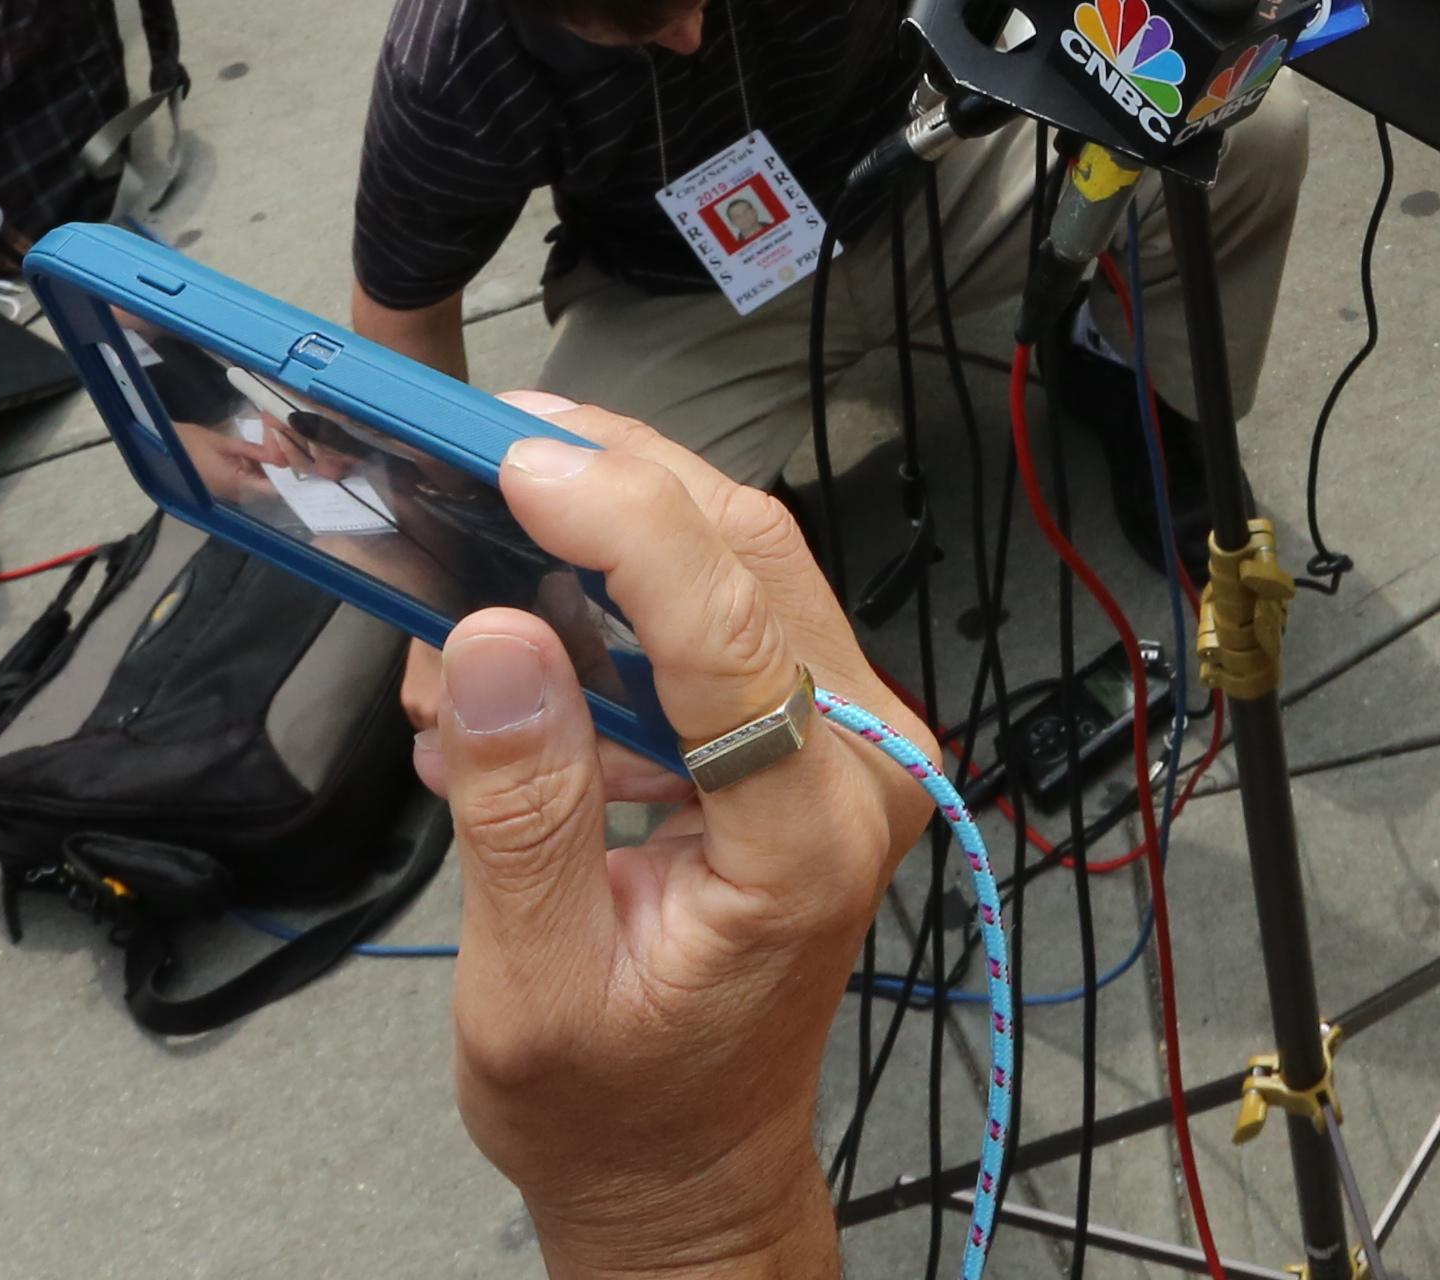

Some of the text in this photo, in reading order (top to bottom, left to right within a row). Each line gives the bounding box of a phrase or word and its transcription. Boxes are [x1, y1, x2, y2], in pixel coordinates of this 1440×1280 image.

[1060, 28, 1171, 142] CNBC
[1172, 80, 1271, 146] CNBC
[675, 183, 696, 200] City
[709, 163, 728, 178] New
[729, 148, 754, 166] York
[696, 182, 728, 207] 2019
[763, 155, 820, 230] PRESS
[677, 211, 733, 286] PRESS
[735, 277, 775, 307] PRESS
